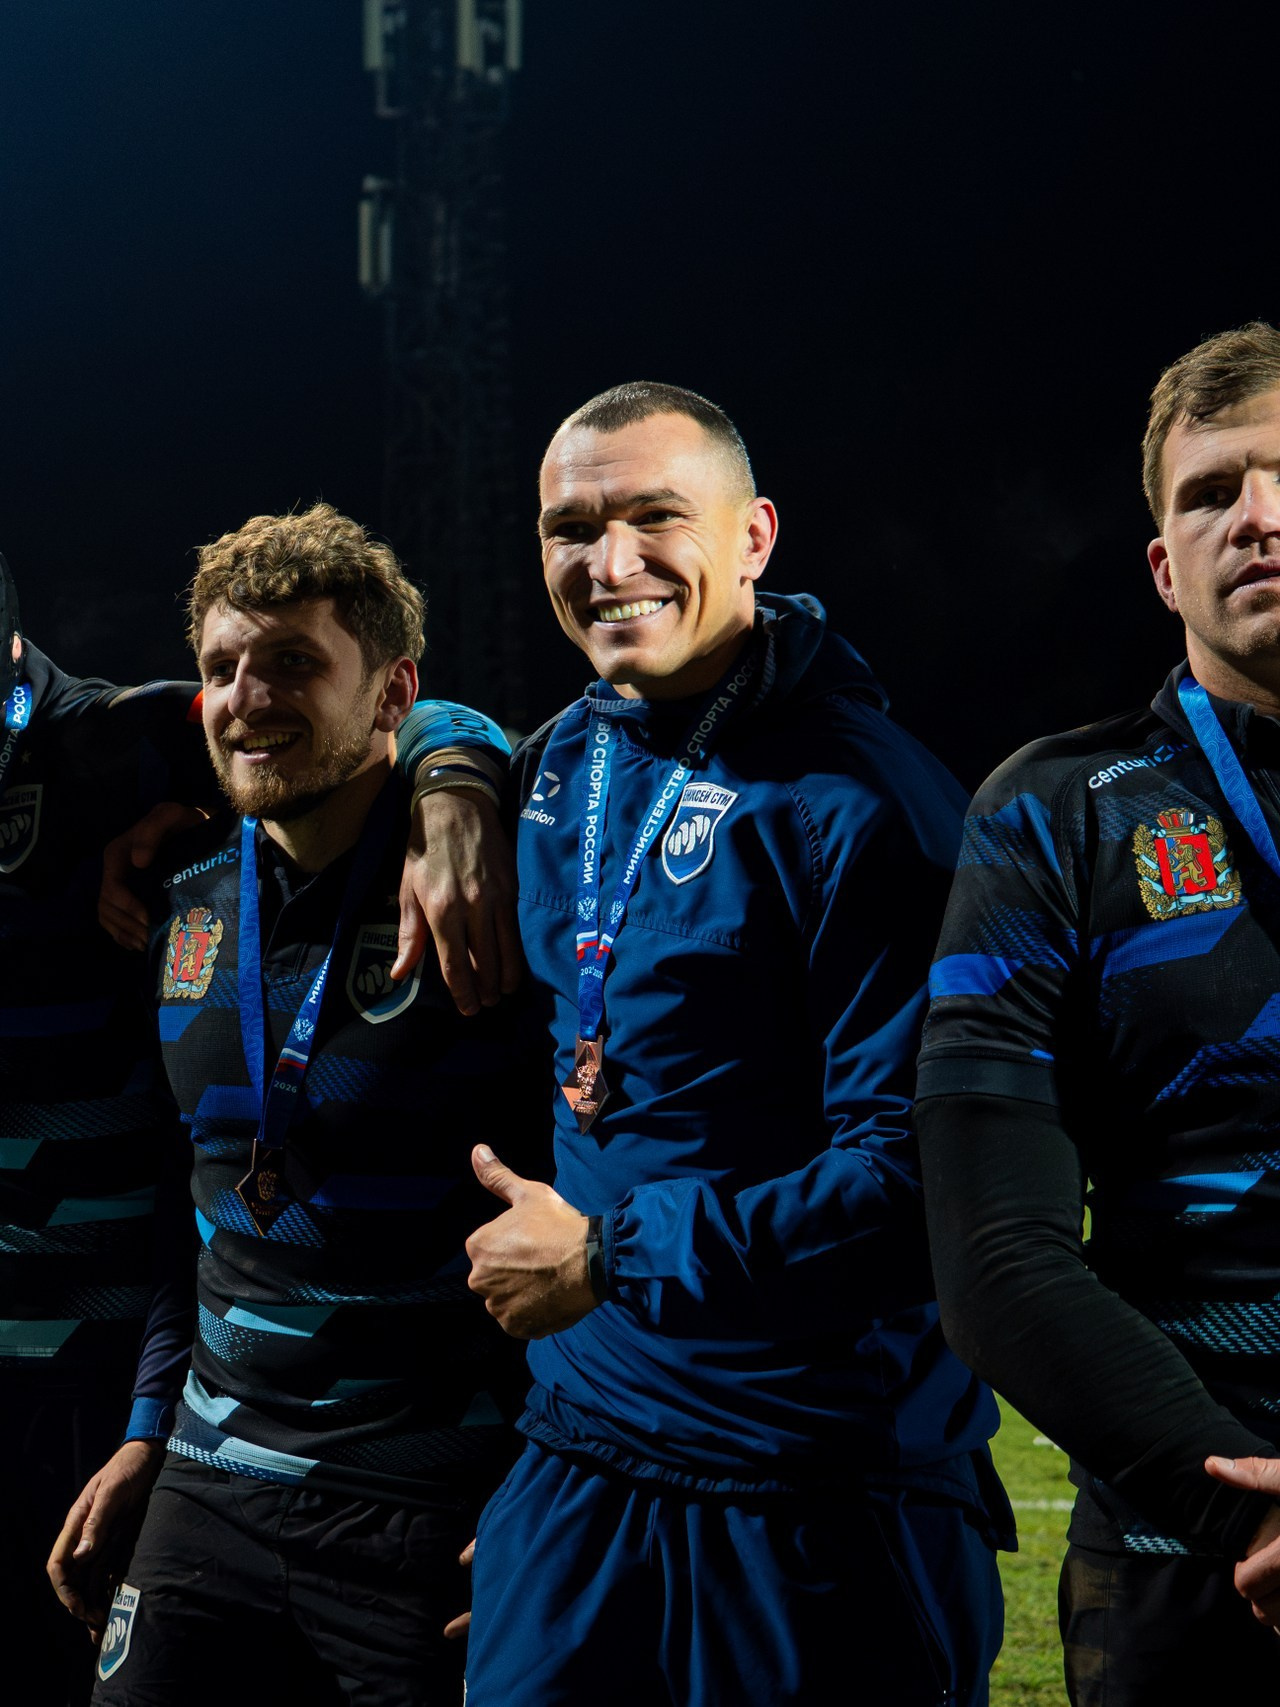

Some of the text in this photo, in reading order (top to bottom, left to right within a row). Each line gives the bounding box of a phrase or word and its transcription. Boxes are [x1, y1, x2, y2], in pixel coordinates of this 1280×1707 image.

[12, 684, 28, 725] РОСС
[587, 747, 608, 812] СПОРТА
[623, 653, 759, 886] МИНИСТЕРСТВО СПОРТА РОСС
[710, 792, 733, 807] СТМ
[162, 847, 240, 889] centurio
[582, 815, 599, 885] РОССИИ
[273, 1080, 298, 1094] 2026
